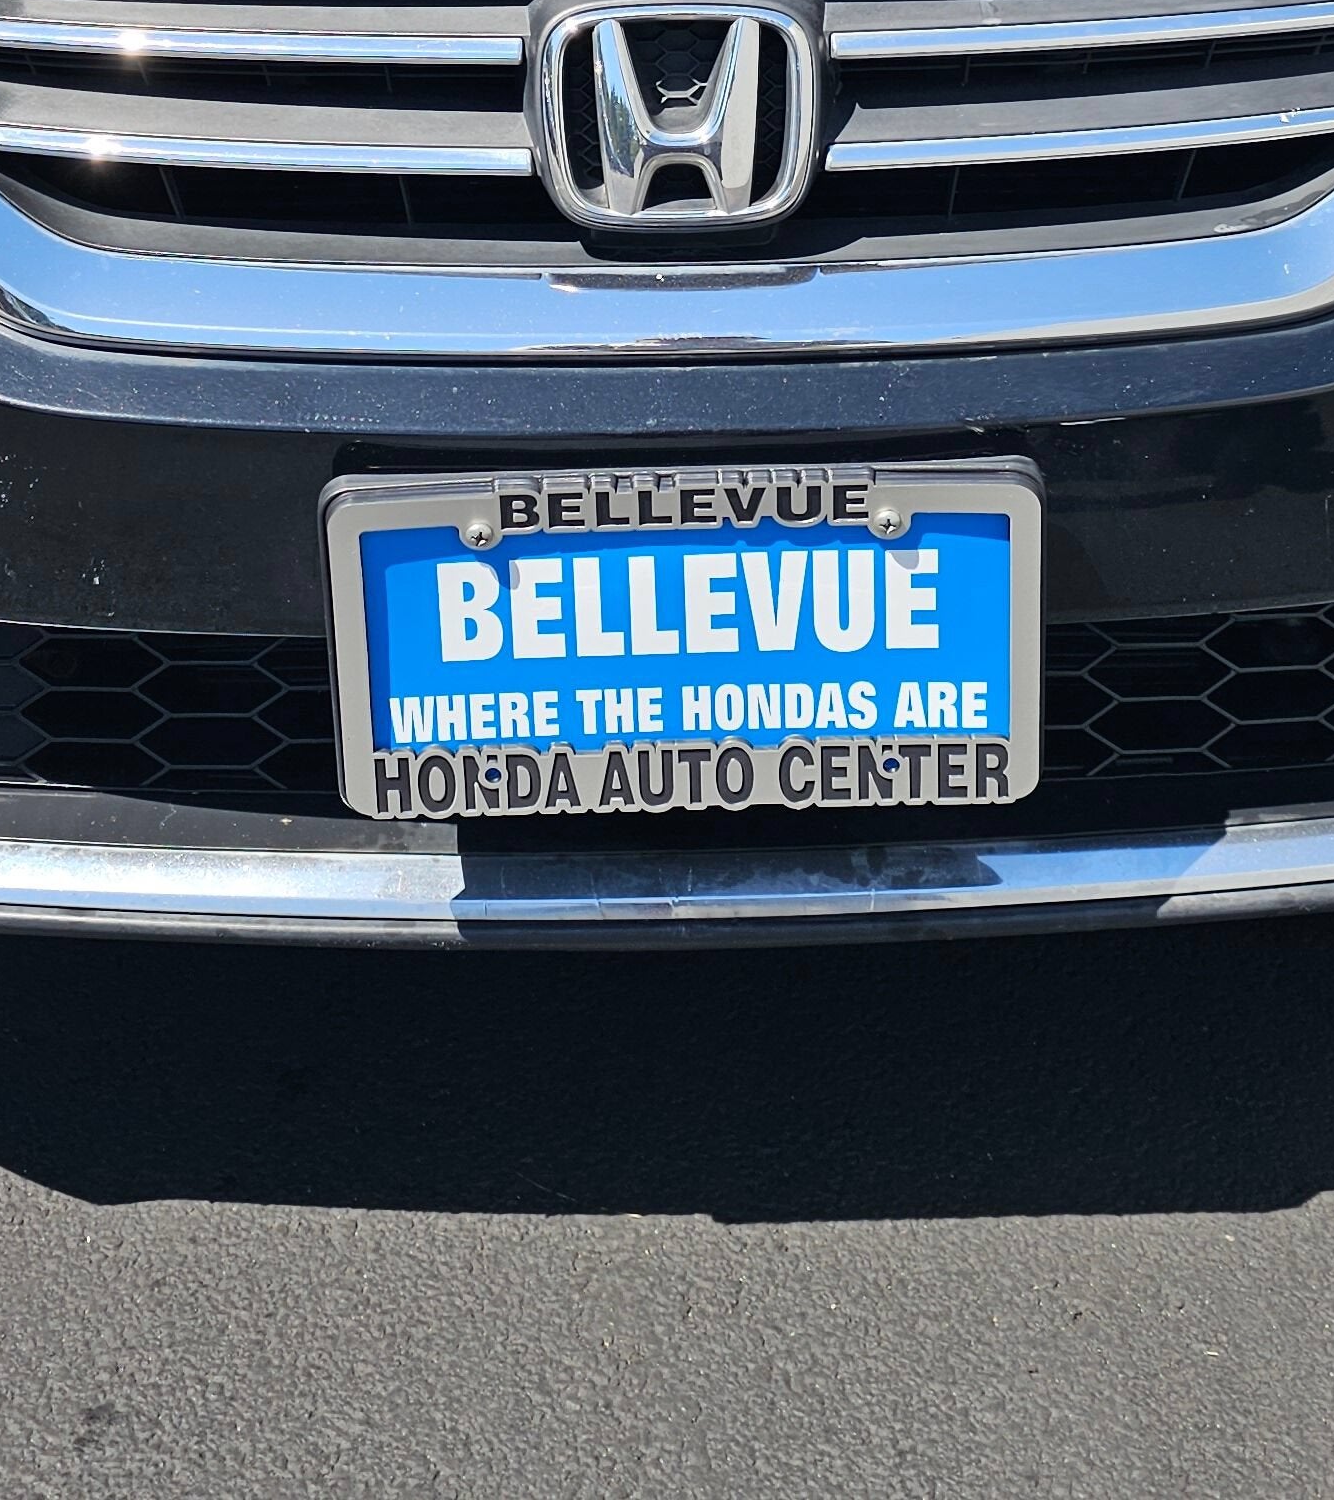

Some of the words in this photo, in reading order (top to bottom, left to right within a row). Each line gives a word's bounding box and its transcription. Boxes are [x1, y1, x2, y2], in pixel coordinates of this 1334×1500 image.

[499, 484, 870, 530] BELLEVUE
[436, 548, 940, 663] BELLEVUE
[389, 690, 560, 744] WHERE
[575, 687, 664, 735] THE
[682, 683, 878, 732] HONDAS
[894, 681, 988, 729] ARE
[374, 751, 573, 815] HONDA
[598, 747, 755, 810] AUTO
[778, 742, 1011, 803] CENTER
